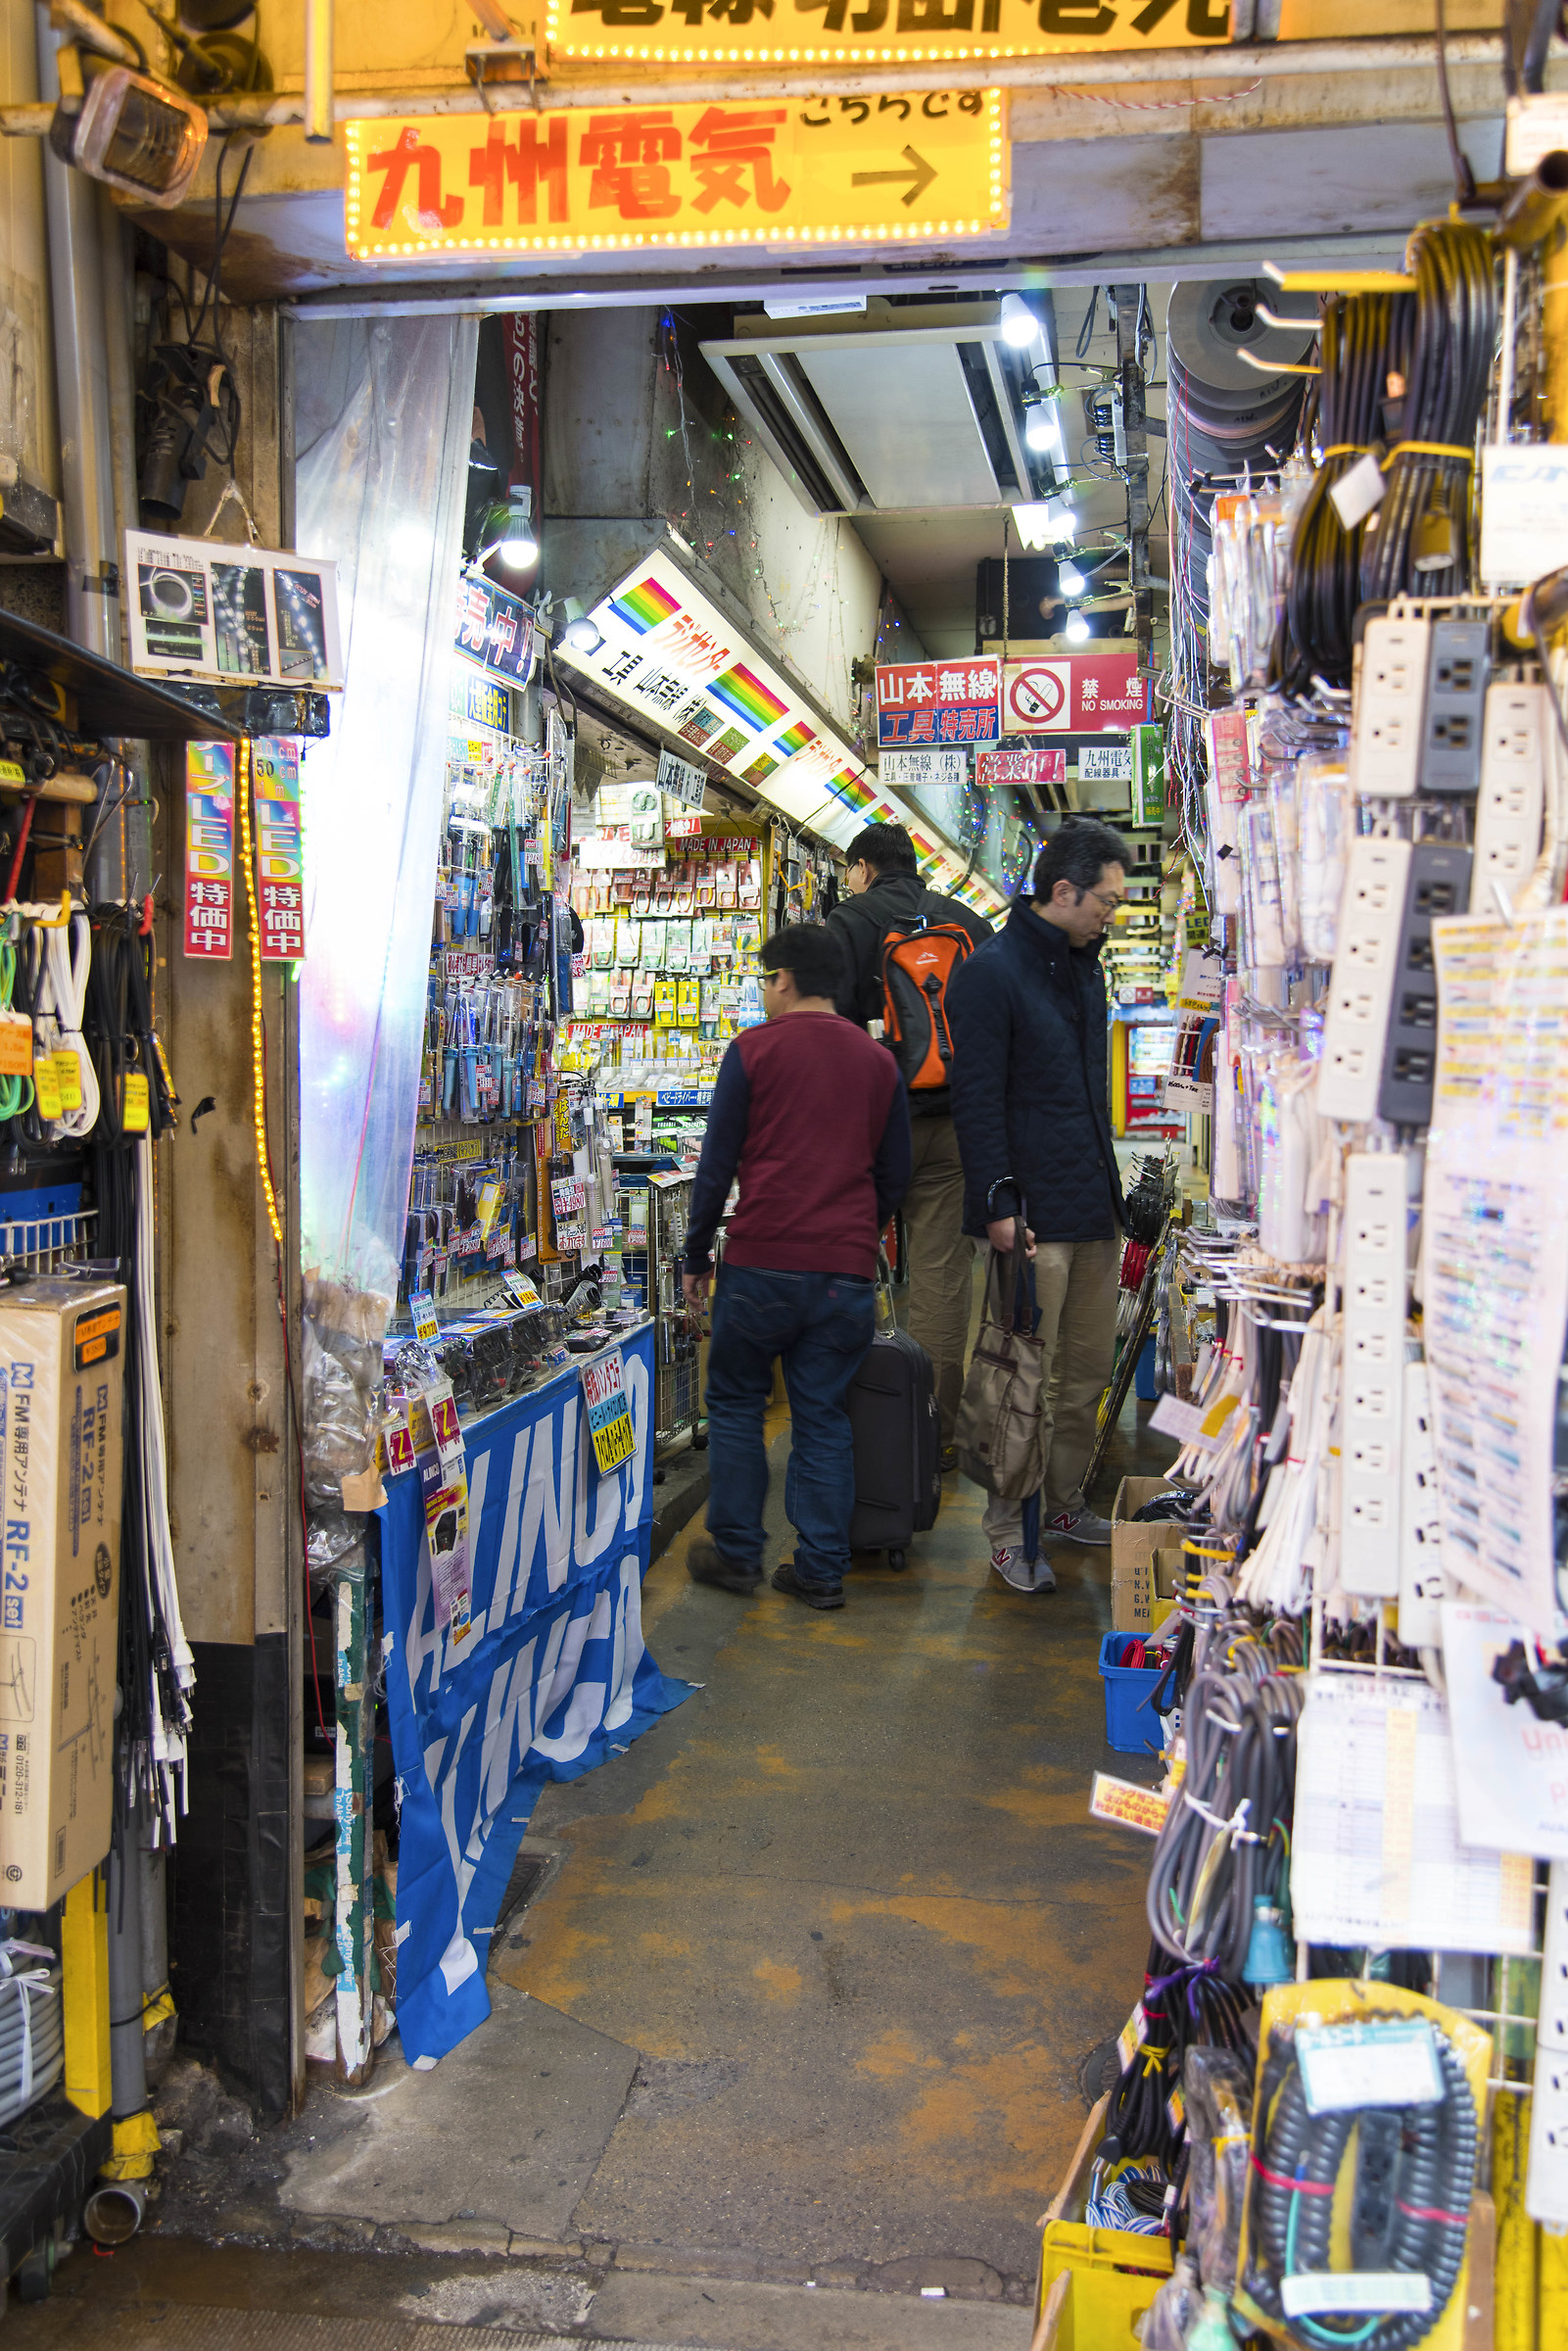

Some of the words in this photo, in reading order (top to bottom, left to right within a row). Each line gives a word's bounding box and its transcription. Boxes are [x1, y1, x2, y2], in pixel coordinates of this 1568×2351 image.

[367, 107, 791, 230] 九州電気
[601, 650, 643, 686] 工具
[879, 668, 997, 705] 山本無線
[1081, 679, 1143, 699] 禁煙
[1081, 700, 1096, 711] NO
[1100, 698, 1143, 711] SMOKING
[882, 707, 995, 743] 工具特売所
[278, 743, 297, 759] cm
[980, 750, 1060, 784] 営業中！
[256, 759, 274, 779] 50
[279, 765, 297, 780] cm
[275, 784, 285, 797] m
[189, 797, 230, 875] LED
[260, 802, 301, 878] LED
[680, 838, 706, 851] MADE
[708, 838, 718, 851] IN
[720, 837, 752, 850] JAPAN
[189, 882, 229, 951] 特価中
[263, 886, 302, 954] 特価中
[559, 1098, 569, 1140] はんだ
[562, 1193, 585, 1212] ¥4980
[594, 1237, 612, 1248] ¥1600
[13, 1393, 31, 1512] FM専用アンテナ
[81, 1406, 96, 1486] RF-2
[422, 1463, 441, 1483] ALINCO
[1051, 1512, 1081, 1531] N
[5, 1518, 30, 1591] RF-2
[15, 1754, 24, 1815] 0120-312-181
